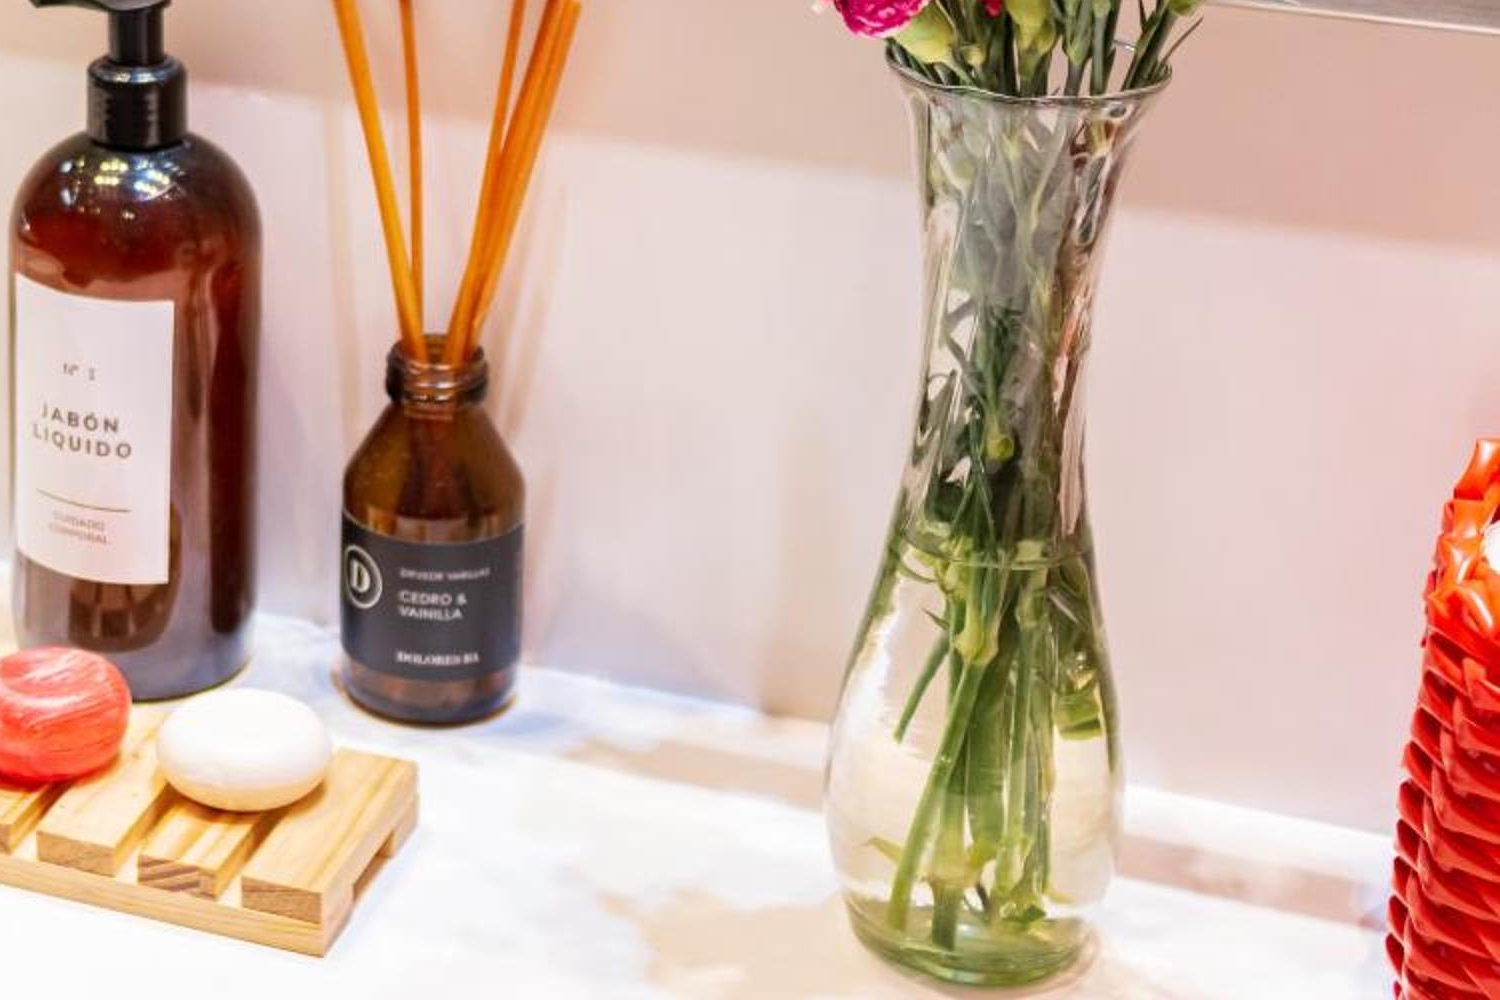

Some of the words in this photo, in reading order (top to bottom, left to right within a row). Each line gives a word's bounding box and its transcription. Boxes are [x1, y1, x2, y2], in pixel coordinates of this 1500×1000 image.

[42, 401, 119, 434] JABÓN
[398, 590, 452, 606] CEDRO
[456, 592, 467, 606] &
[397, 605, 463, 621] VAINILLA
